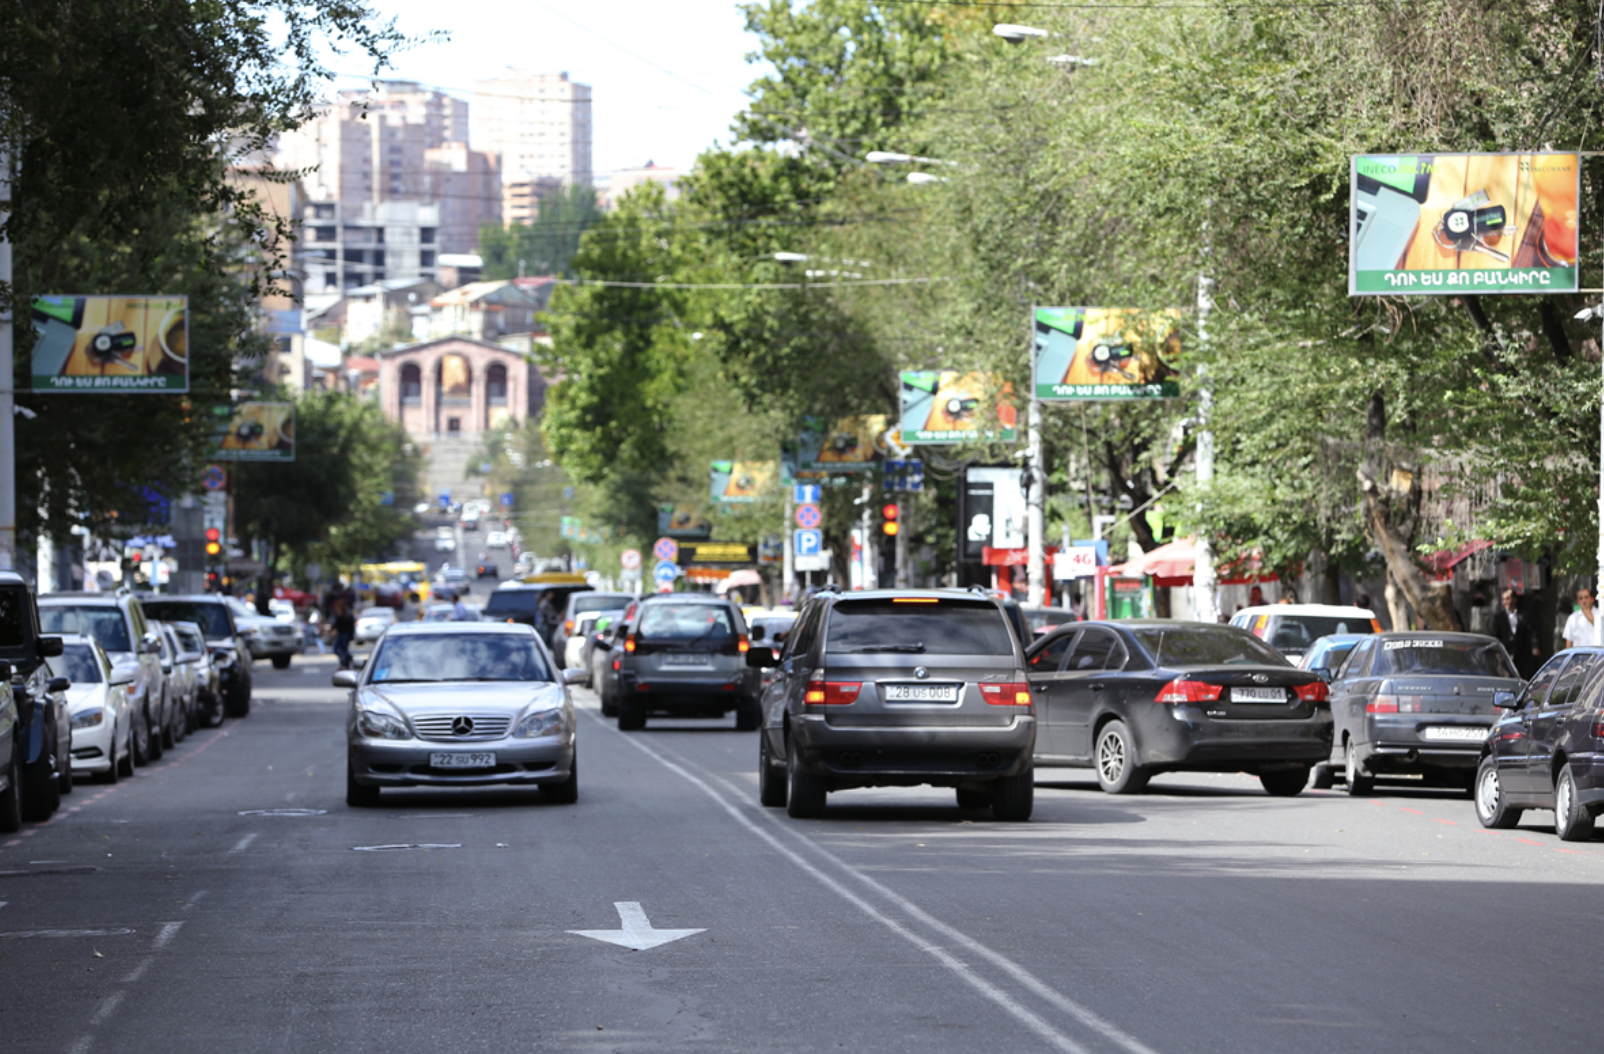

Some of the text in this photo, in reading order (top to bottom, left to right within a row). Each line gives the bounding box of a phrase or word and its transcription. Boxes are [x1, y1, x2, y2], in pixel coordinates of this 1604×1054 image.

[1384, 270, 1551, 287] ԴՈՒ ԵՍ ՔՈ ԲԱՆԿԻՐԸ
[802, 532, 817, 554] P
[1073, 553, 1092, 565] 4G
[896, 686, 950, 698] 28 US 008
[439, 754, 491, 765] 22 SU 992
